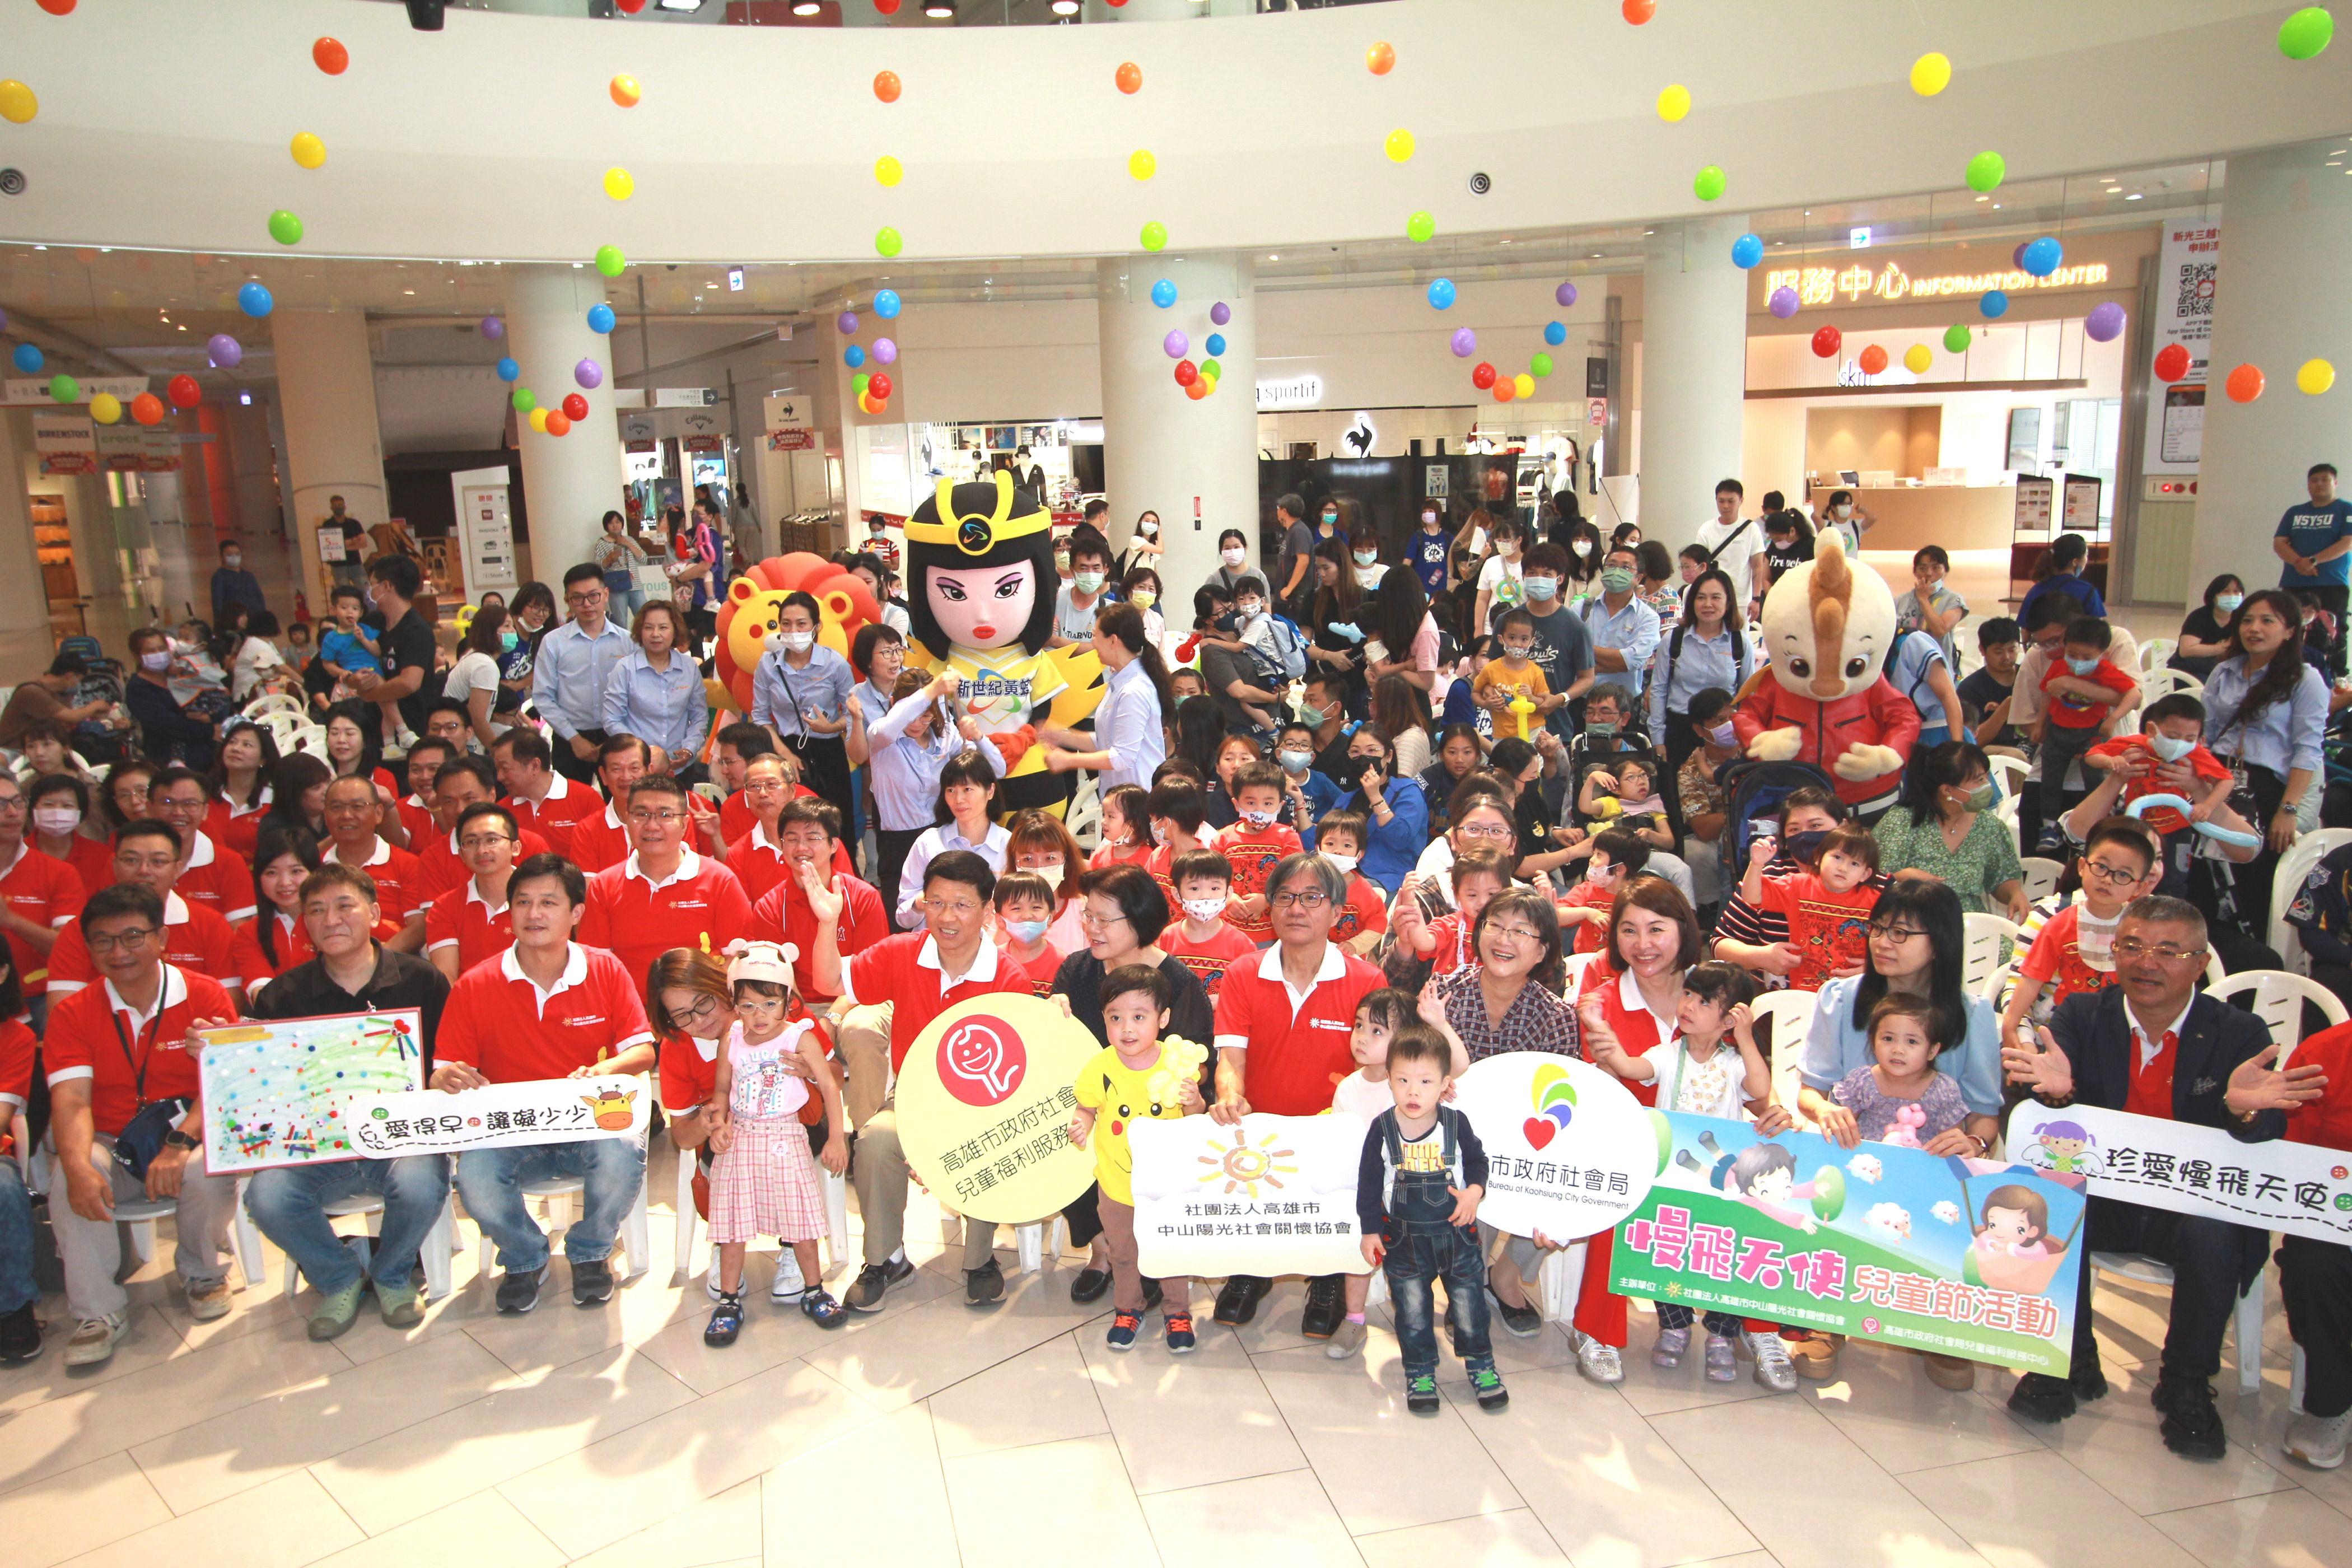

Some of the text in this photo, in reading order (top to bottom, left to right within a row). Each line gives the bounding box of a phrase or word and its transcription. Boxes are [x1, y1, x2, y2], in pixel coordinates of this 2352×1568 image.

[1764, 262, 1909, 306] 服務中心
[1912, 264, 2107, 296] INFORMATION CENTER
[1265, 381, 1315, 402] sportif
[38, 430, 90, 439] BIRKENSTOCK
[2293, 514, 2334, 526] NSYSU
[958, 679, 1031, 697] 新世紀黃蜂
[385, 1105, 587, 1139] 愛得早 讓礙少少
[939, 1085, 1078, 1175] 高雄市政府社會
[955, 1123, 1074, 1203] 兒童福利服務
[1491, 1154, 1628, 1196] 市政府社會局
[2106, 1147, 2329, 1212] 珍愛慢飛天使
[1185, 1202, 1320, 1216] 社團法人高雄市
[1488, 1180, 1513, 1191] Bureau
[1524, 1187, 1562, 1201] Kaohsiung
[1565, 1192, 1579, 1203] City
[1581, 1194, 1629, 1210] Government
[1158, 1221, 1351, 1236] 中山陽光社會關懷協會
[1625, 1203, 2060, 1341] 慢飛天使 兒童節活動
[1683, 1287, 1845, 1326] 社團法人高雄市中山陽光社會關懷協會
[1883, 1324, 2049, 1366] 高雄市政府社會局兒童福利服務中心
